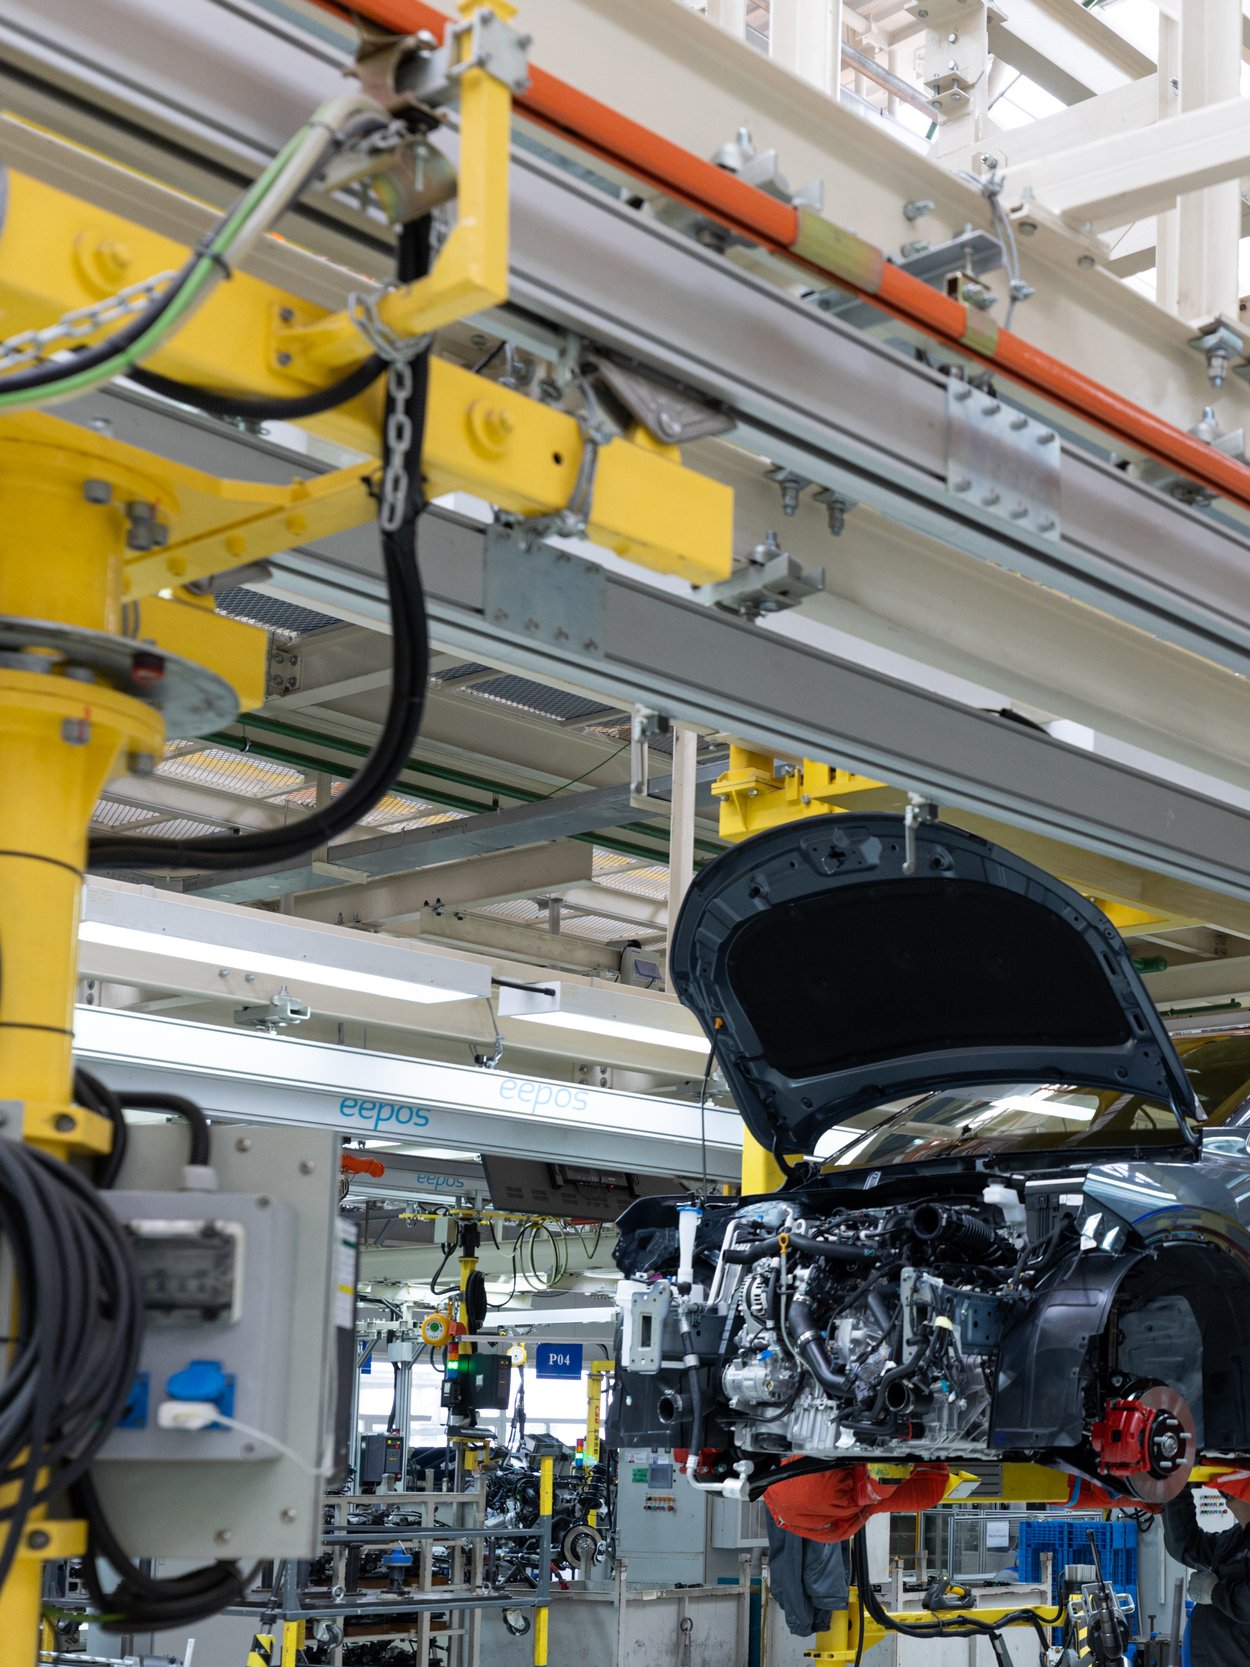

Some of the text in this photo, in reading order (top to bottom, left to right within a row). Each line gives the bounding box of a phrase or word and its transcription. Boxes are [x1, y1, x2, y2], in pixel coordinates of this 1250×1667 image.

[500, 1078, 589, 1113] eepos
[339, 1097, 431, 1130] eepos
[416, 1174, 464, 1190] eepos
[549, 1353, 571, 1366] P04
